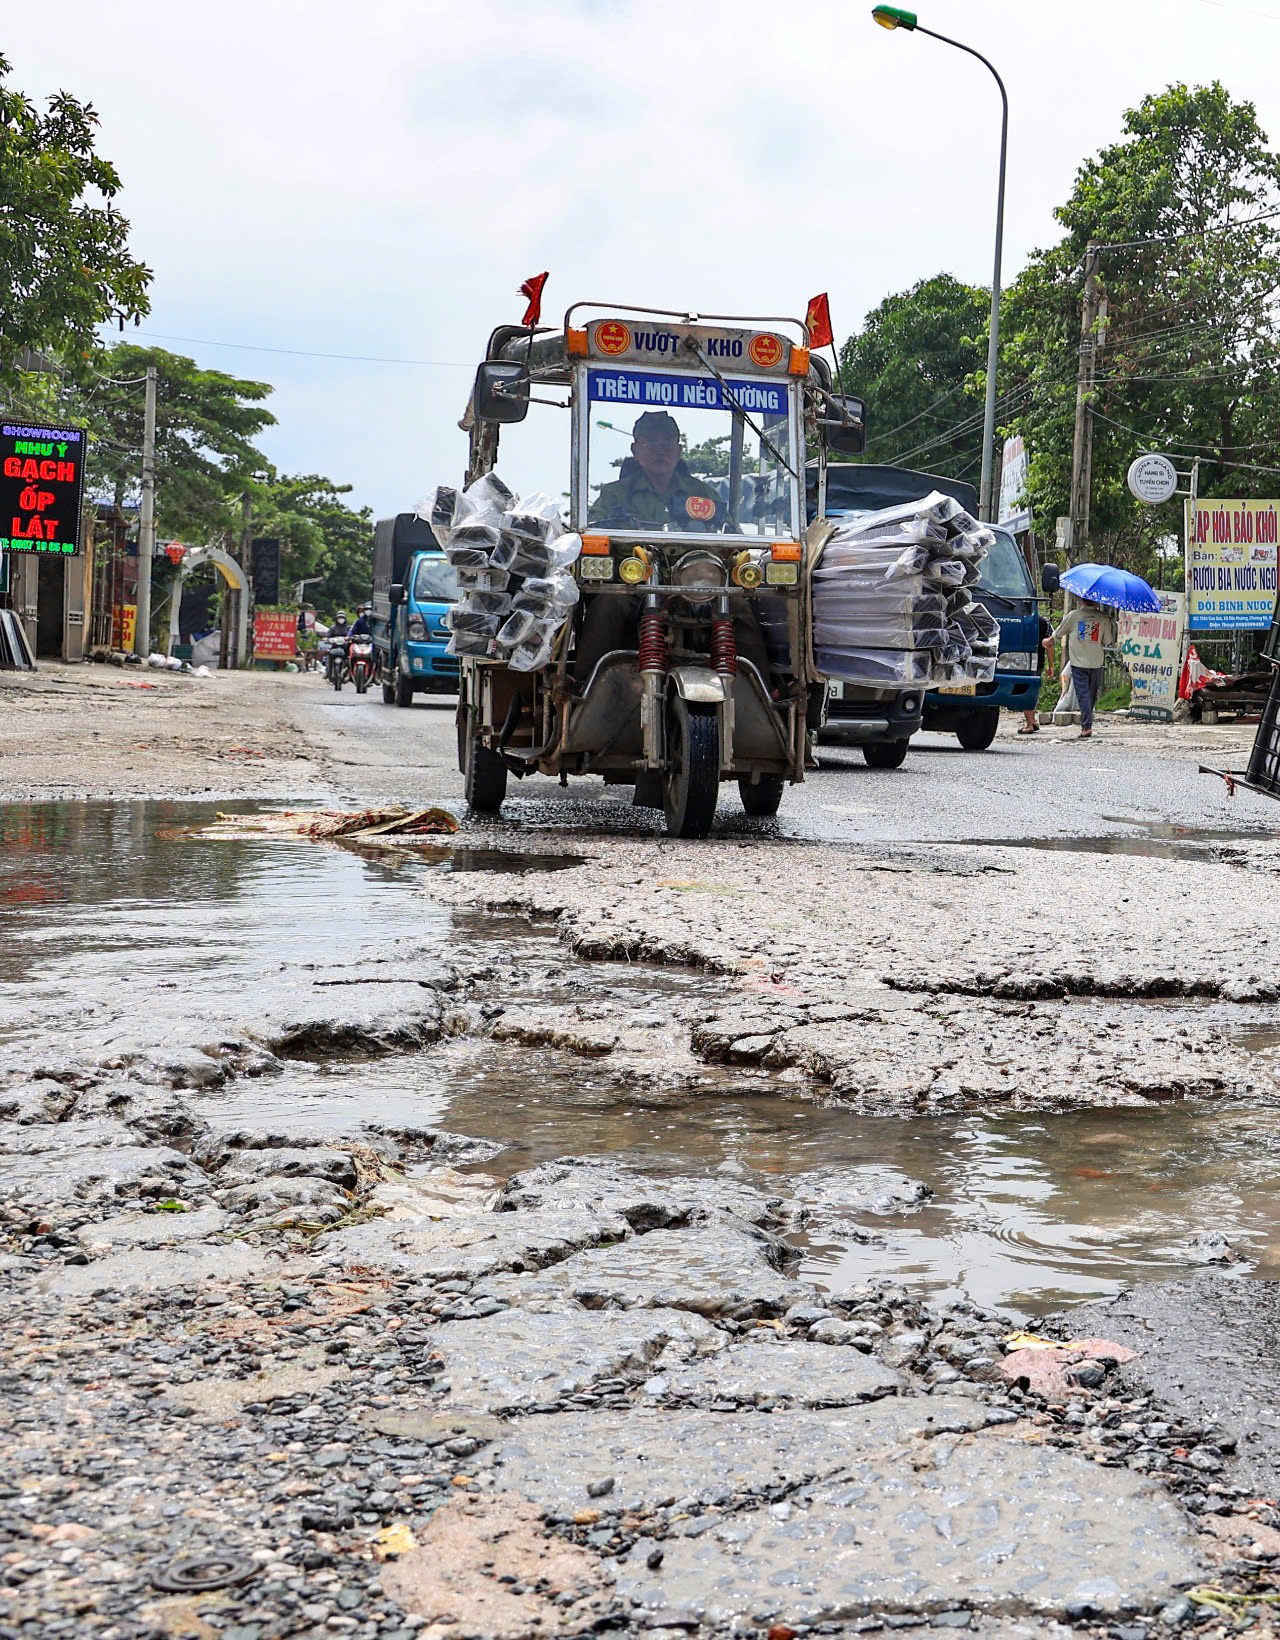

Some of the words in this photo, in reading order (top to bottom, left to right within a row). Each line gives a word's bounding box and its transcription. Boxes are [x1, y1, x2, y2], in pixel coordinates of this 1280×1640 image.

[634, 331, 680, 356] VƯỢT
[707, 334, 744, 358] KHÓ
[595, 375, 641, 400] TRÊN
[645, 381, 679, 405] MỌI
[683, 380, 717, 405] NẺO
[2, 425, 80, 442] SHOWROOM
[15, 441, 55, 456] NHƯ
[56, 442, 69, 457] Ý
[4, 457, 75, 483] GẠCH
[20, 484, 56, 512] ỐP
[12, 515, 60, 540] LÁT
[1212, 504, 1232, 543] HÓA
[1233, 502, 1253, 543] BẢO
[1255, 504, 1278, 543] KHÔI
[1193, 565, 1216, 596] RƯỢU
[1218, 567, 1232, 590] BIA
[1234, 562, 1257, 590] NƯỚC
[1260, 566, 1278, 595] NGỌ
[995, 617, 1022, 625] ONTIER
[1161, 619, 1177, 640] BIA
[1143, 643, 1162, 659] LÁ
[1132, 661, 1158, 675] SÁCH
